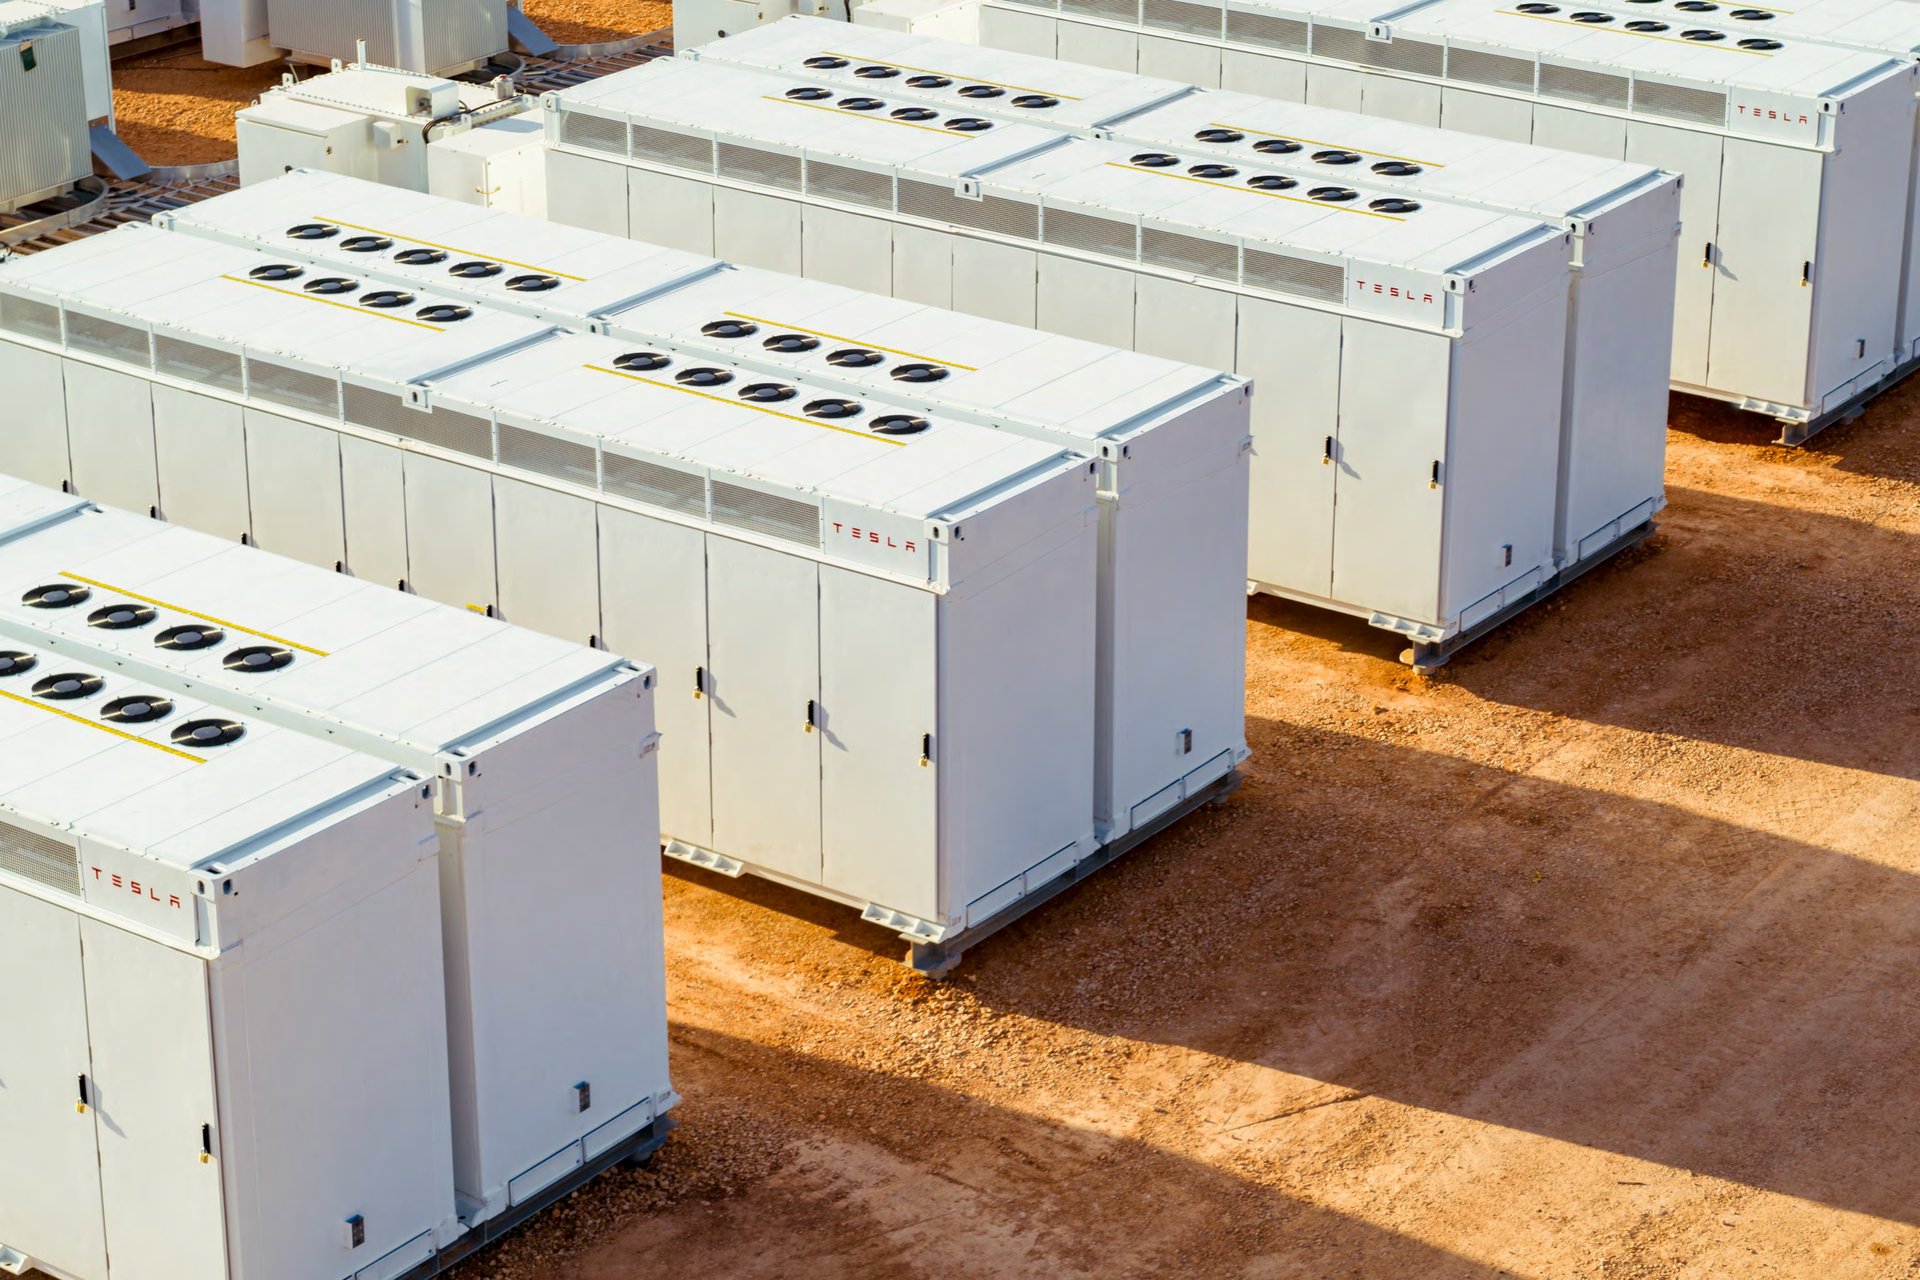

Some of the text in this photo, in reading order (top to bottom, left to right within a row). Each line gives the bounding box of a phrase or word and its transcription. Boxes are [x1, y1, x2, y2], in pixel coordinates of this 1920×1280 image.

[1738, 105, 1807, 125] TESLA
[1356, 280, 1433, 303] TESLA
[833, 522, 917, 553] TESLA
[91, 866, 181, 909] TESLA
